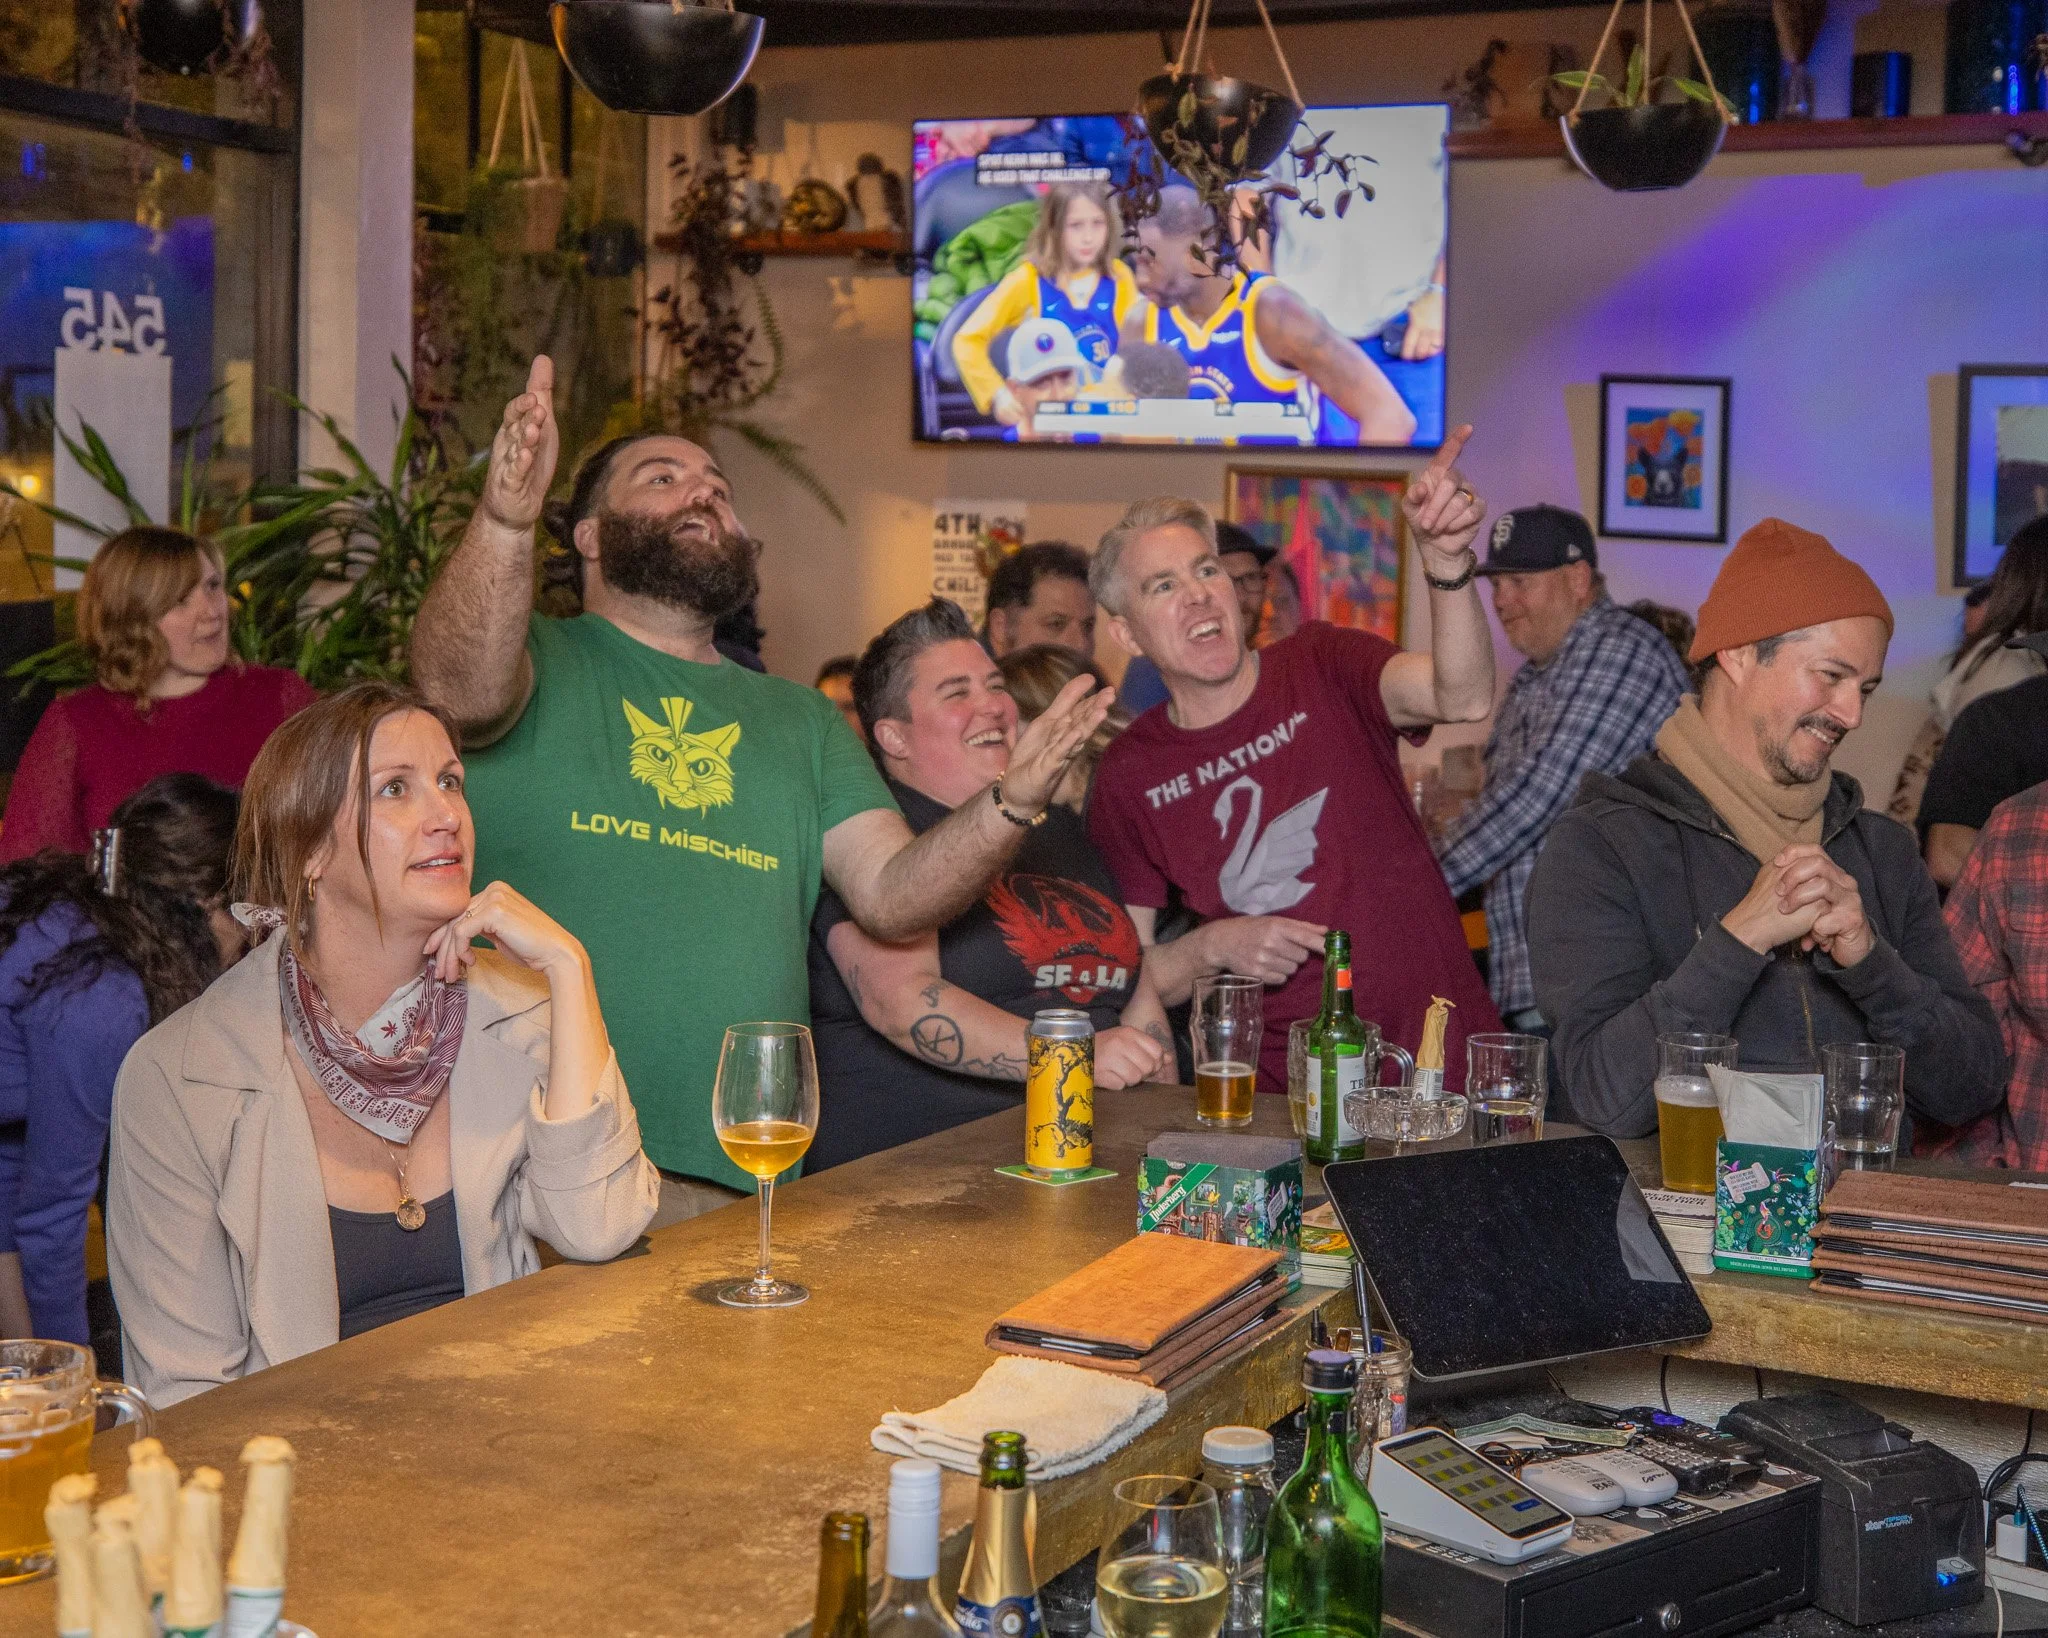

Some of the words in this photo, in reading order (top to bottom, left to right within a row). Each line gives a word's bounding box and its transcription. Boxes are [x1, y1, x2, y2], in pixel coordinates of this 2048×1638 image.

[934, 513, 981, 534] 4TH
[1145, 773, 1192, 808] THE
[571, 811, 651, 841] LOVE
[1035, 964, 1072, 988] SF
[1095, 965, 1127, 989] LA
